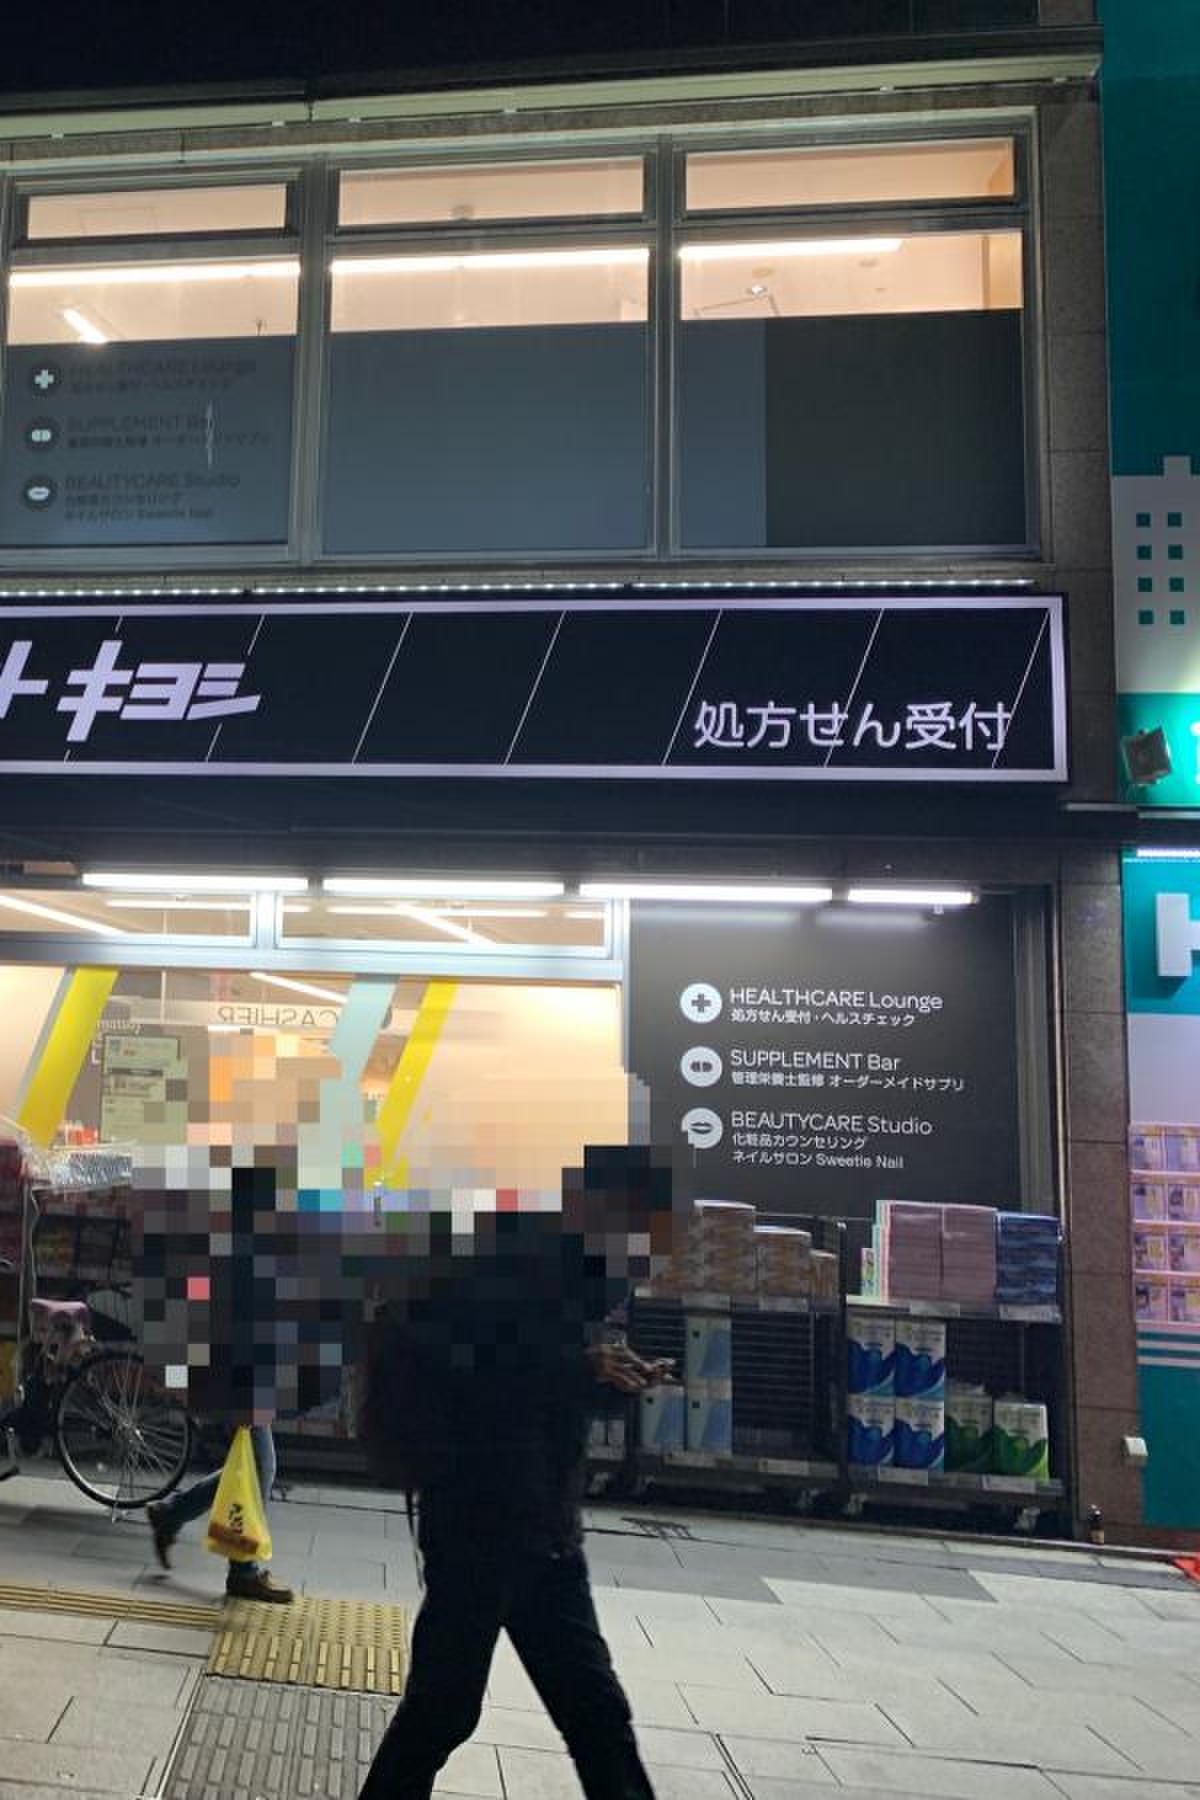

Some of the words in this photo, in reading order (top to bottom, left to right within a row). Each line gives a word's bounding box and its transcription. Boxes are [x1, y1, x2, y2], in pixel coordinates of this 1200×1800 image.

[694, 700, 1013, 751] 処方せん受付
[730, 987, 865, 1008] HEALTHCARE
[869, 991, 944, 1013] Lounge
[731, 1049, 863, 1070] SUPPLEMENT
[867, 1053, 901, 1072] Bar
[731, 1111, 864, 1133] BEAUTYCARE
[867, 1114, 933, 1135] Studio
